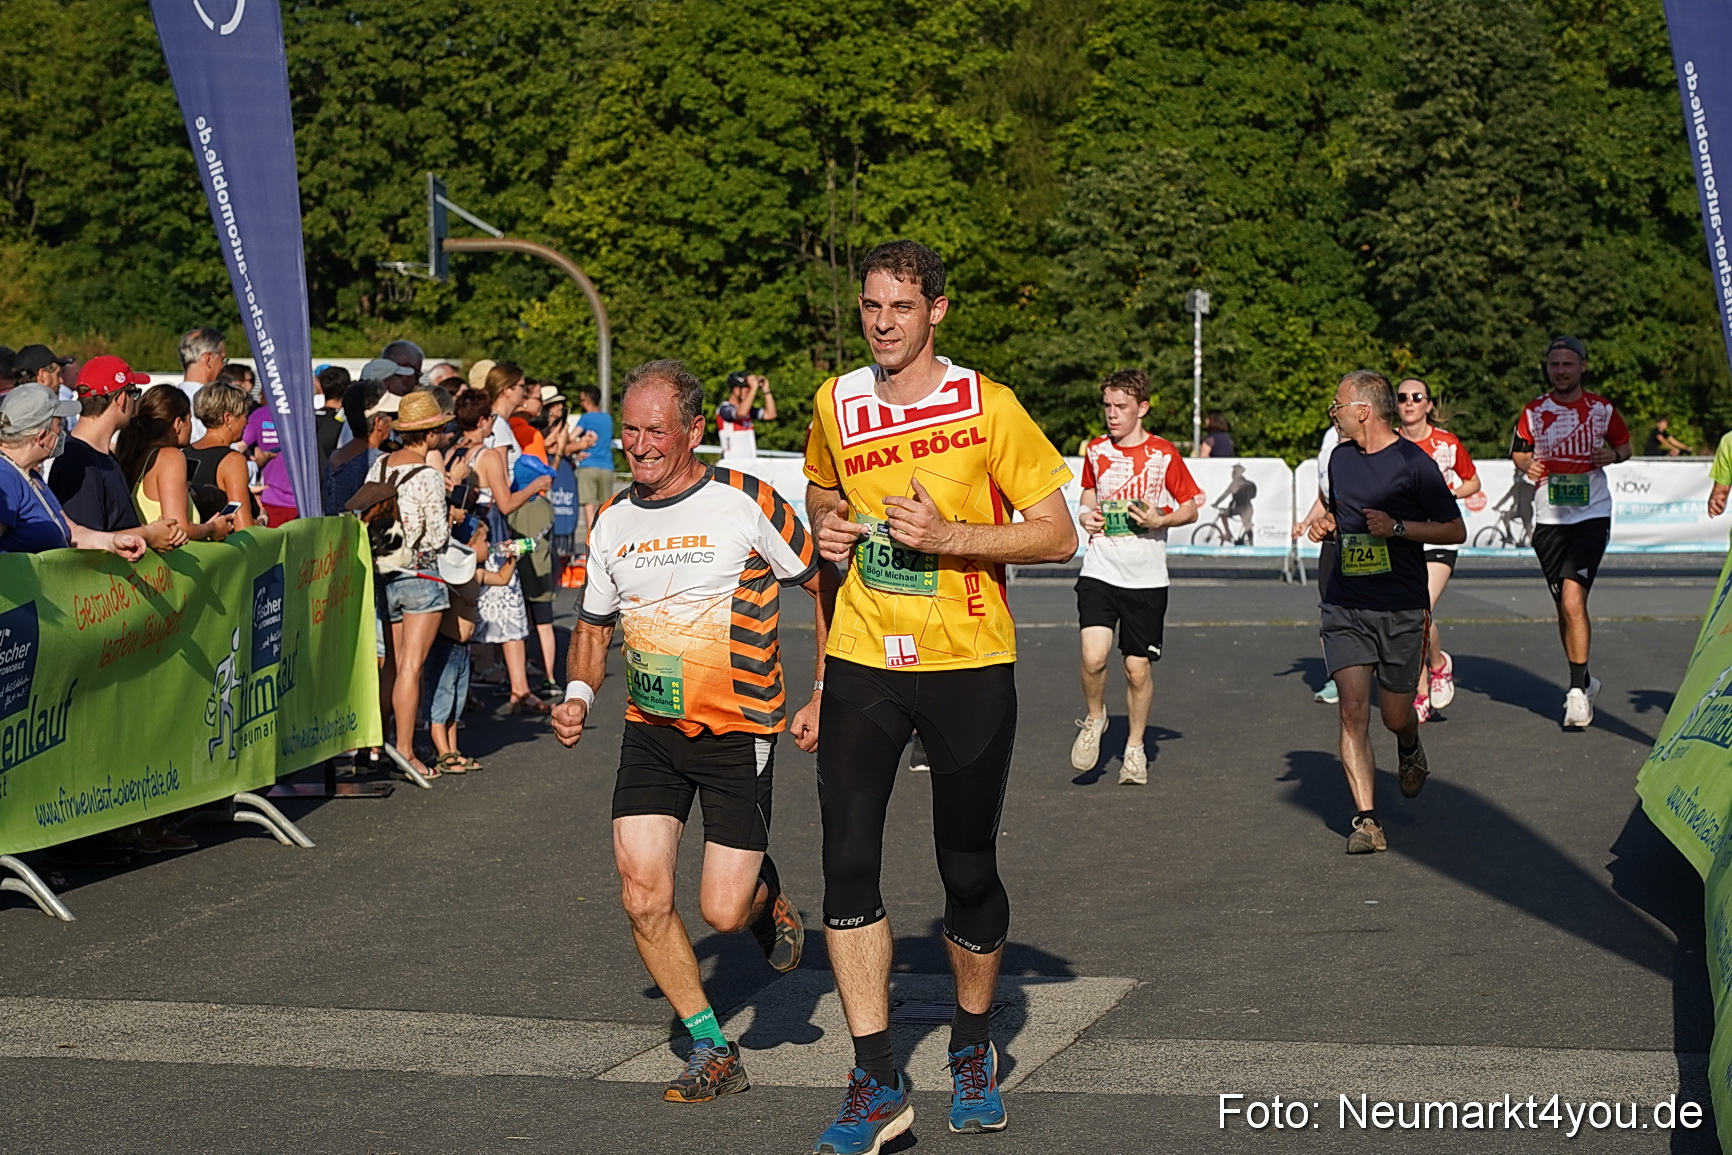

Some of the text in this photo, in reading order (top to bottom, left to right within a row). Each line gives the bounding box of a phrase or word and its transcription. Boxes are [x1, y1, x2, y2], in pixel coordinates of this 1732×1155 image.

[844, 426, 987, 477] MAX BÖGL
[1554, 485, 1583, 496] 1126
[1616, 481, 1651, 494] NOW
[1107, 512, 1129, 525] 111
[638, 535, 716, 554] KLEBL
[635, 551, 716, 569] DYNAMICS
[866, 540, 923, 571] 1587
[1349, 547, 1375, 562] 724
[866, 566, 918, 582] Bögl Michael
[924, 555, 934, 586] 2022
[74, 573, 130, 631] Gesunde
[0, 641, 32, 666] scher
[0, 660, 26, 676] TOMOBILE
[634, 669, 665, 696] 404
[650, 695, 674, 706] Roland
[672, 681, 681, 711] 2022
[1, 677, 79, 769] enlauf
[35, 760, 180, 827] www.firmenlauf-oberpfalz.de
[840, 916, 864, 926] cep
